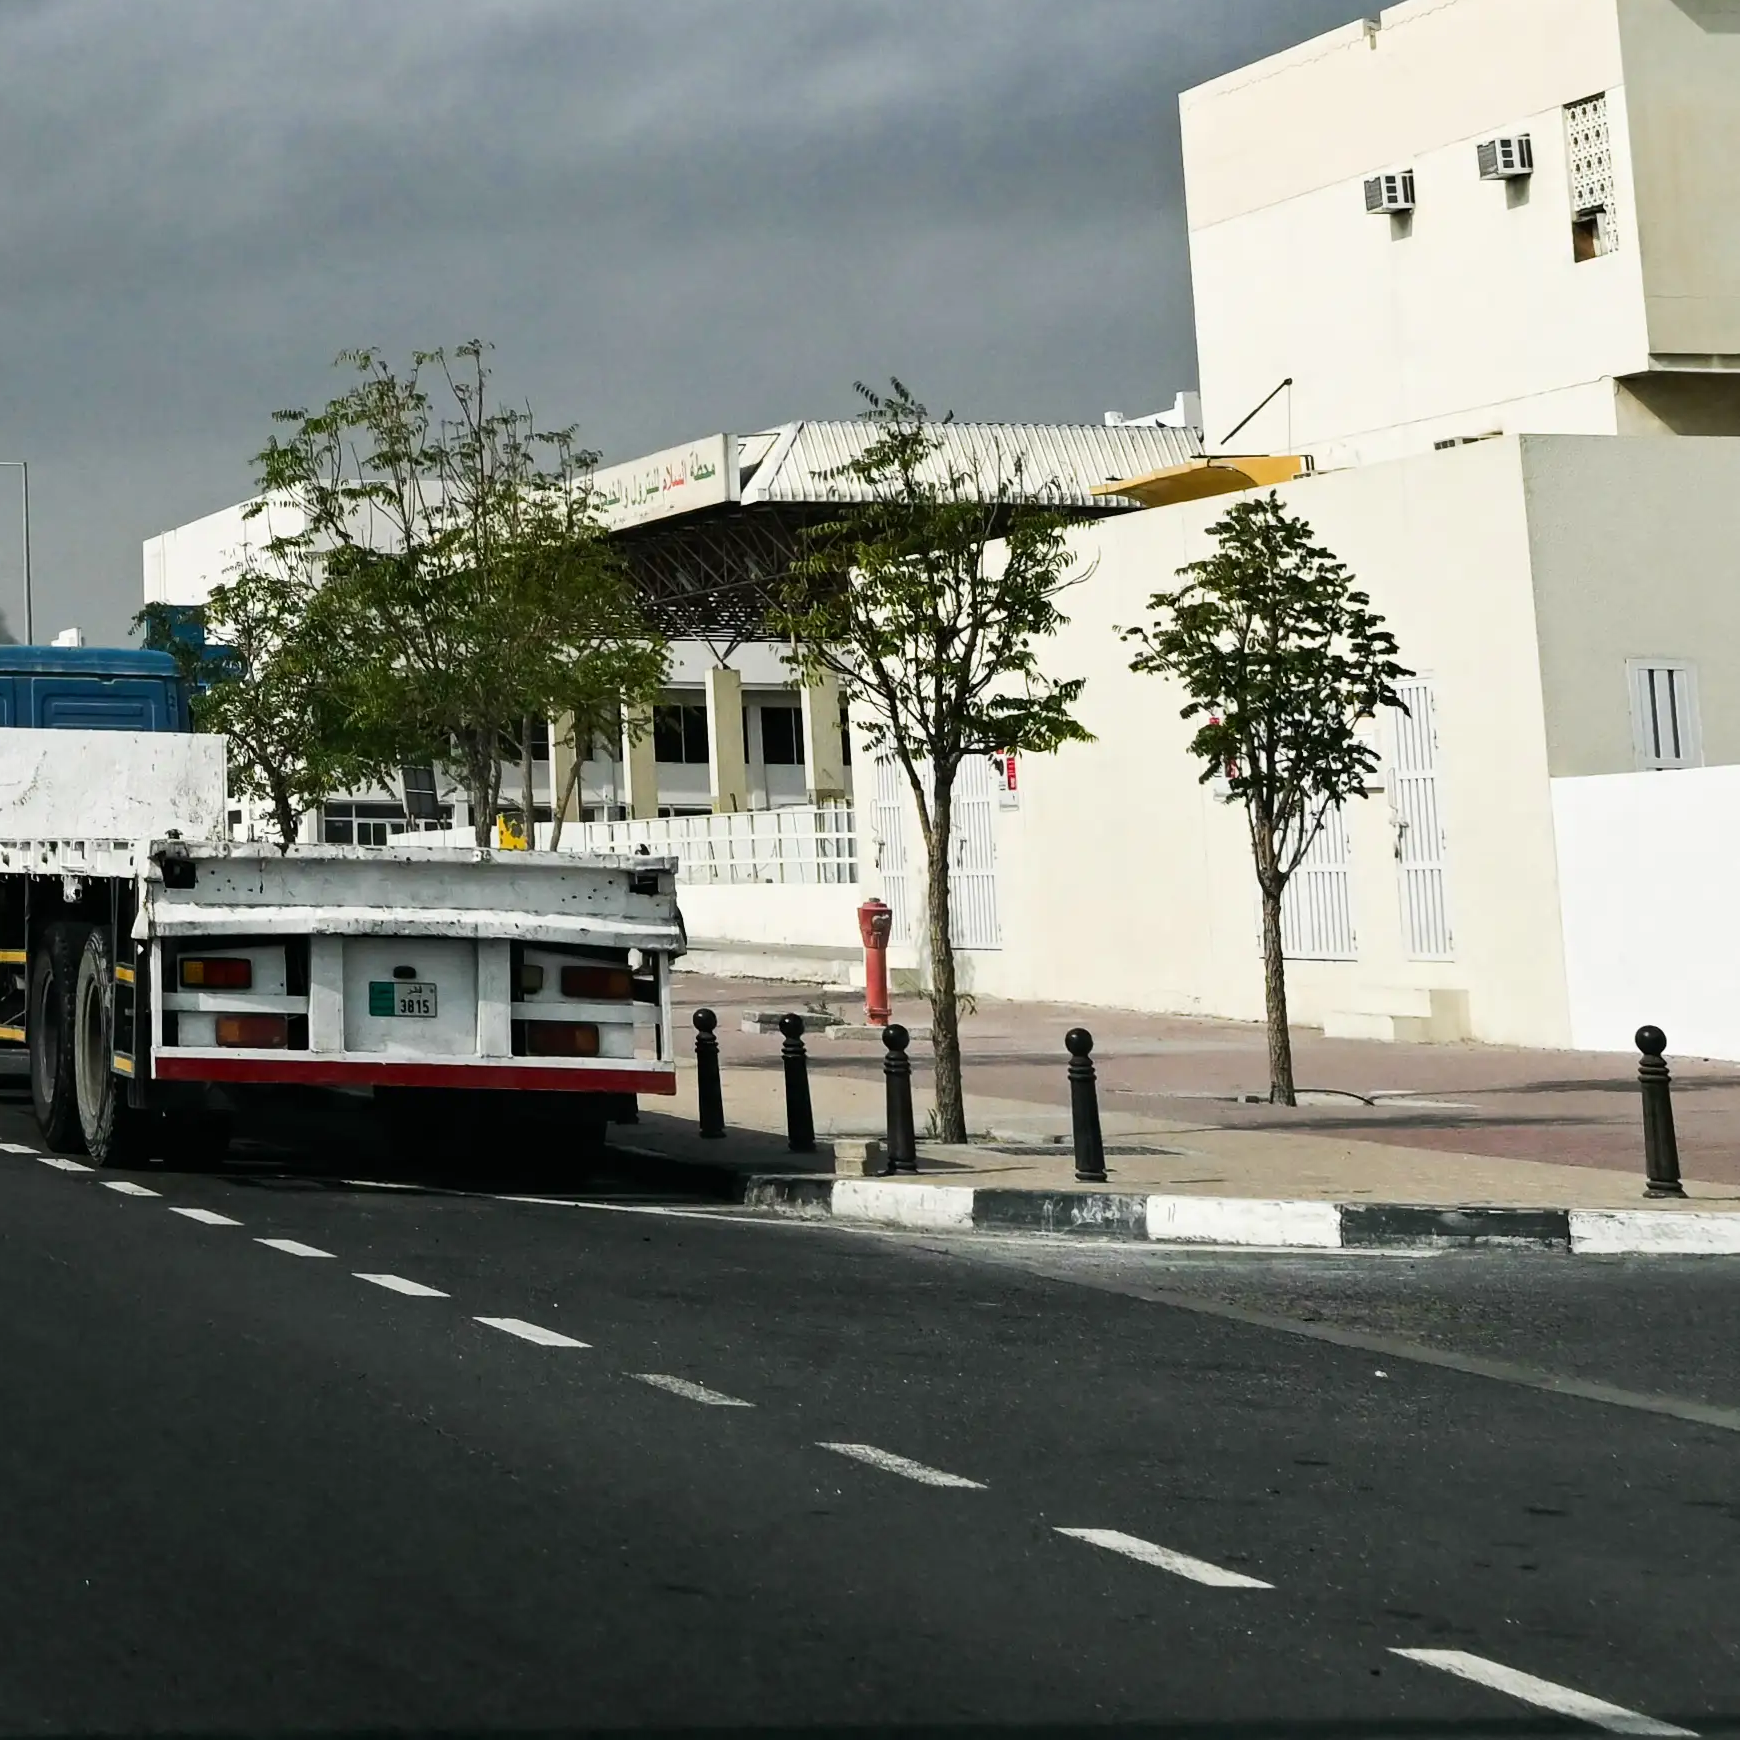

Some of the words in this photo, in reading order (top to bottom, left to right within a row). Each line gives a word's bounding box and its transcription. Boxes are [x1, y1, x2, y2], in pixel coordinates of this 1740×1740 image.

[662, 459, 687, 502] السلام
[689, 450, 715, 482] محطة
[399, 998, 430, 1014] 3815
